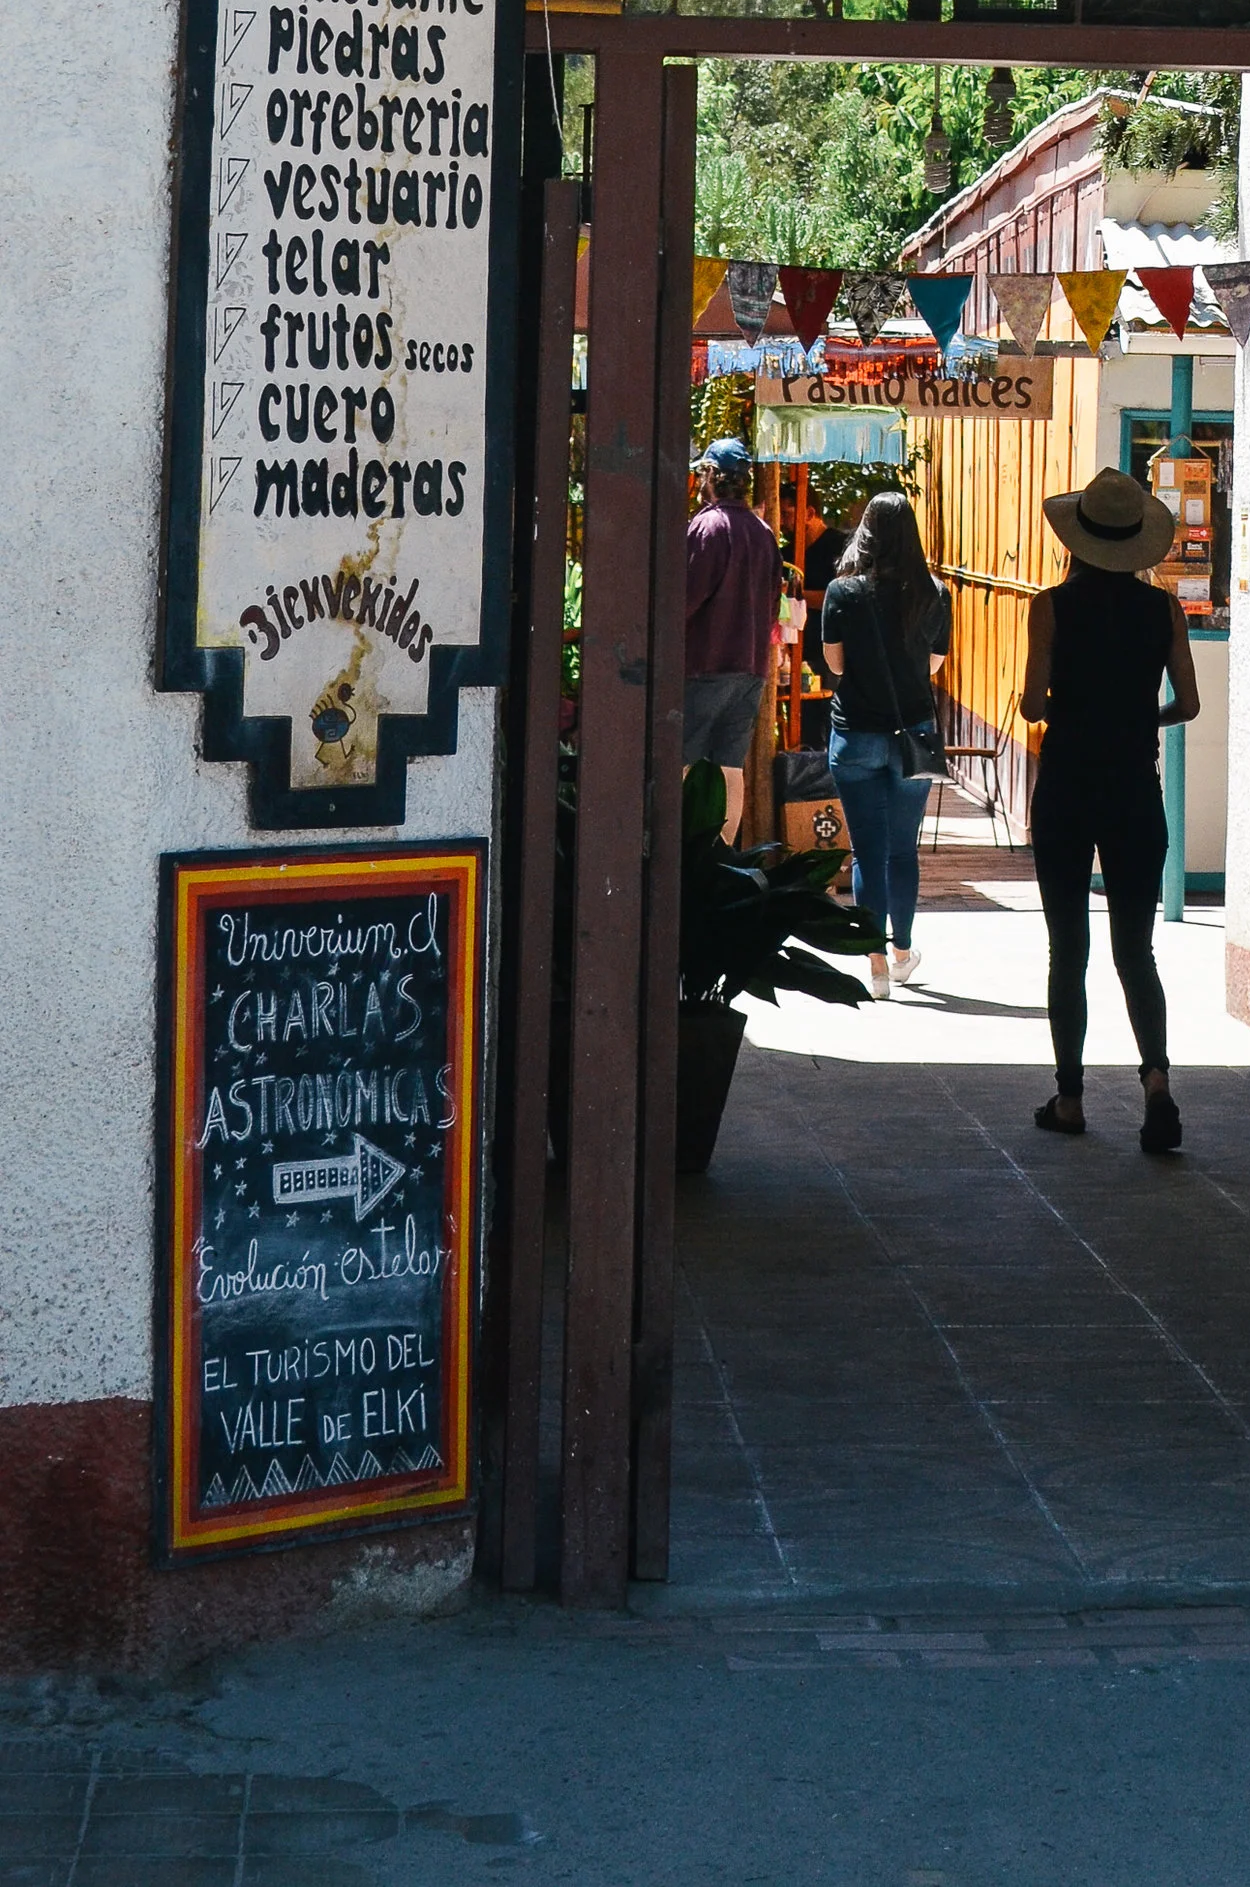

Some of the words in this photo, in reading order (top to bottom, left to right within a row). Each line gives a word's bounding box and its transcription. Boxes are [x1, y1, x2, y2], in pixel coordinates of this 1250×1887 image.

[266, 83, 489, 158] orfebreria
[264, 158, 483, 229] vestuario
[262, 229, 391, 299] telar
[260, 303, 394, 373] frutos
[405, 339, 475, 373] secos
[259, 383, 396, 444] cuero
[781, 372, 906, 406] Pasio
[253, 447, 468, 520] maderas
[239, 571, 433, 663] Bienvenidos
[228, 974, 422, 1052] CHARLAS
[204, 1356, 238, 1392] EL
[246, 1337, 376, 1386] TURISMO
[387, 1333, 435, 1372] DEL
[221, 1399, 307, 1454] VALLE
[323, 1413, 352, 1444] DE
